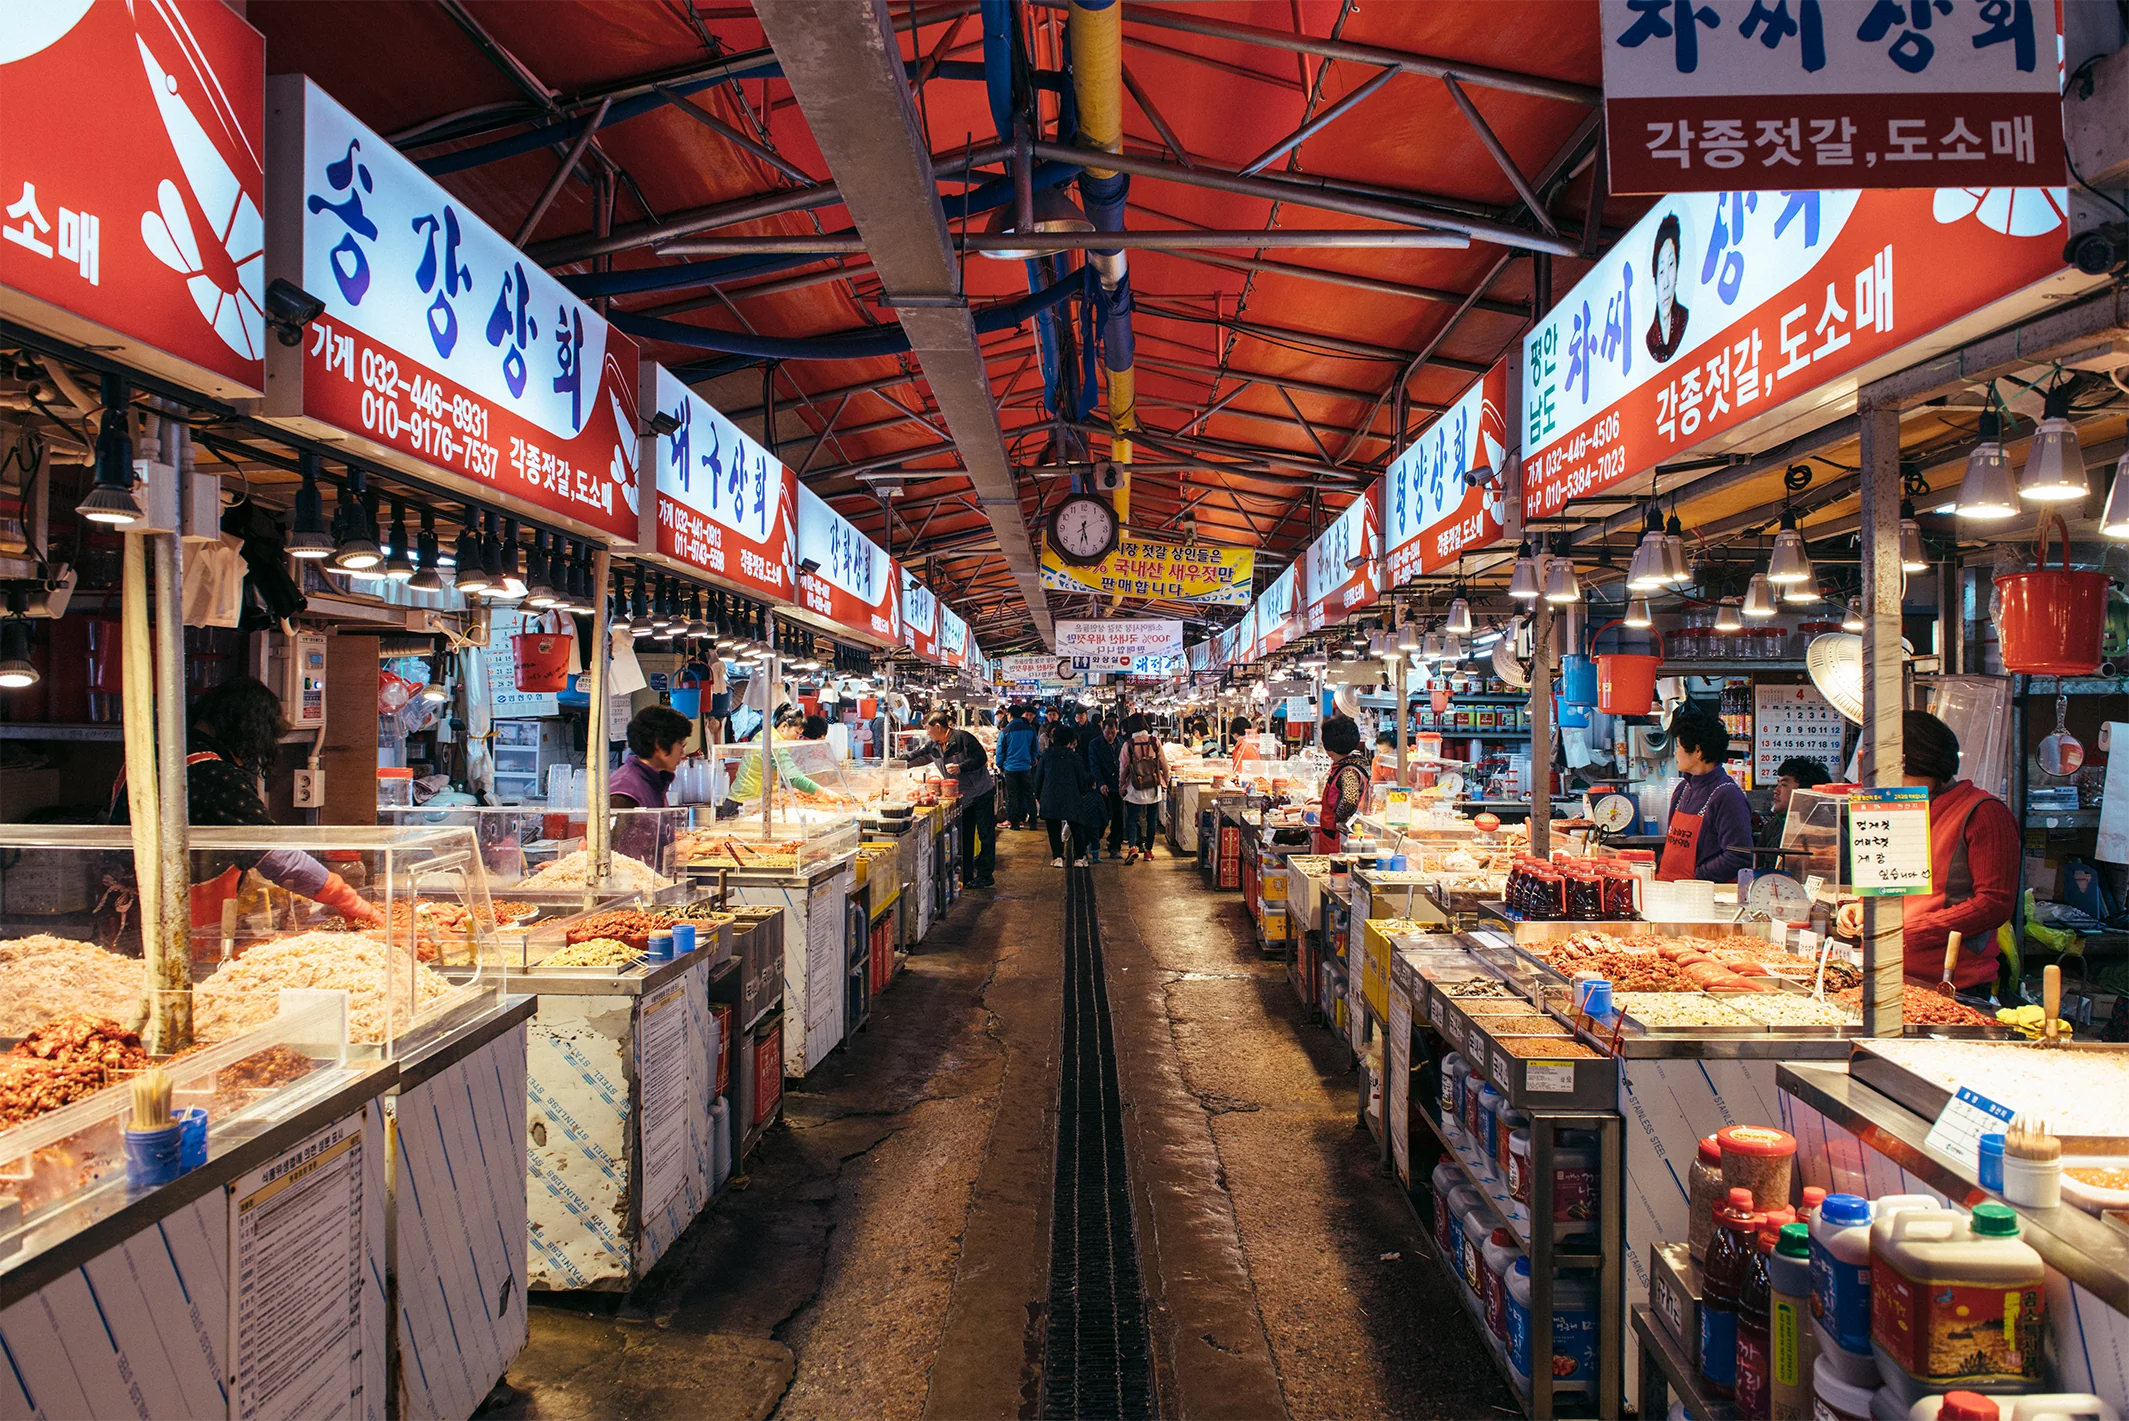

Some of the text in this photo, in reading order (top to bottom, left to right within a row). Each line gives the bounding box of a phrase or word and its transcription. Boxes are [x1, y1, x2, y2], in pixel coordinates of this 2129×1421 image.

[1645, 115, 2037, 169] 각종젓갈,도소매
[1654, 243, 1895, 445] 각종젓갈,도소매
[311, 322, 488, 441] 가게 032-446-8931
[361, 392, 499, 480] 010-9176-7537
[1527, 410, 1620, 488] 가게 032-446-4506
[510, 435, 613, 516] 각종젓갈,도소매
[1545, 444, 1625, 510] 010-5384-7023
[1114, 558, 1164, 578] 국내산
[1168, 564, 1236, 584] 새우젓만
[1142, 544, 1168, 560] 젓갈
[1171, 546, 1223, 564] 상인들은
[1101, 576, 1190, 597] 판매합니다.
[1796, 689, 1804, 700] 4
[594, 1068, 618, 1096] STEEL
[546, 1096, 590, 1141] STAINLESS
[1629, 1096, 1665, 1159] STAINLESS STEEL
[592, 1143, 616, 1168] STEEL
[546, 1170, 590, 1212] STAINLESS
